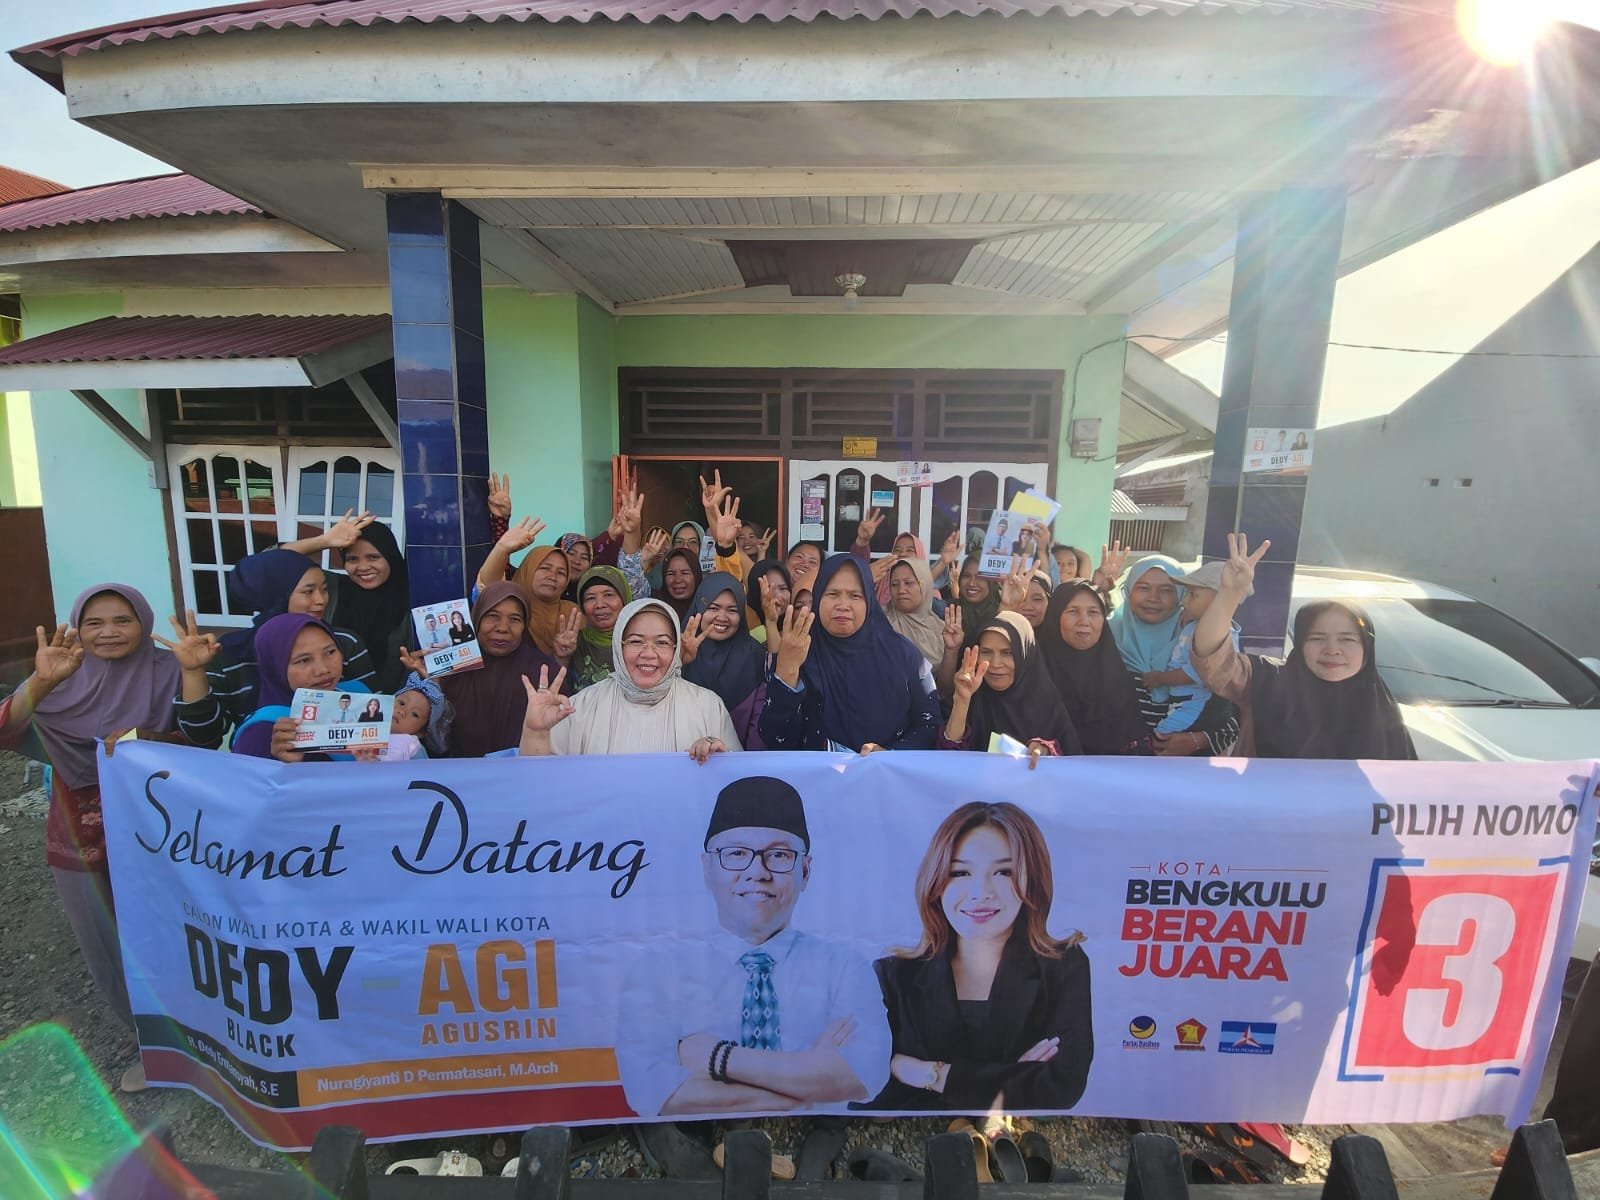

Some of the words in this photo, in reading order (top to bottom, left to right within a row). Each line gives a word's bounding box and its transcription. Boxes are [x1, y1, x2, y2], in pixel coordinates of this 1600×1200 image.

[1270, 455, 1288, 465] DEDY
[987, 559, 1007, 569] DEDY
[433, 651, 455, 666] DEDY
[304, 706, 315, 720] 3
[328, 728, 354, 740] DEDY
[361, 727, 378, 737] AGI
[134, 770, 348, 881] Selamat
[391, 780, 650, 899] Datang
[1371, 803, 1464, 836] PILIH
[1158, 862, 1221, 876] KOTA
[1126, 879, 1327, 909] BENGKULU
[183, 901, 223, 931] CALON
[228, 917, 267, 940] WALI
[276, 921, 332, 938] KOTA
[339, 920, 354, 936] &
[362, 919, 431, 936] WAKIL
[436, 917, 488, 934] WALI
[496, 916, 550, 933] KOTA
[1121, 908, 1307, 946] BERANI
[185, 922, 355, 1025] DEDY
[418, 939, 559, 1016] AGI
[1118, 943, 1288, 982] JUARA
[1402, 892, 1517, 1052] 3
[227, 1017, 297, 1058] BLACK
[421, 1017, 557, 1046] AGUSRIN
[260, 1080, 280, 1096] S.E
[317, 1072, 400, 1092] Nuragiyanti
[404, 1071, 414, 1083] D
[417, 1065, 507, 1082] Permatasari,
[509, 1061, 559, 1077] M.Arch
